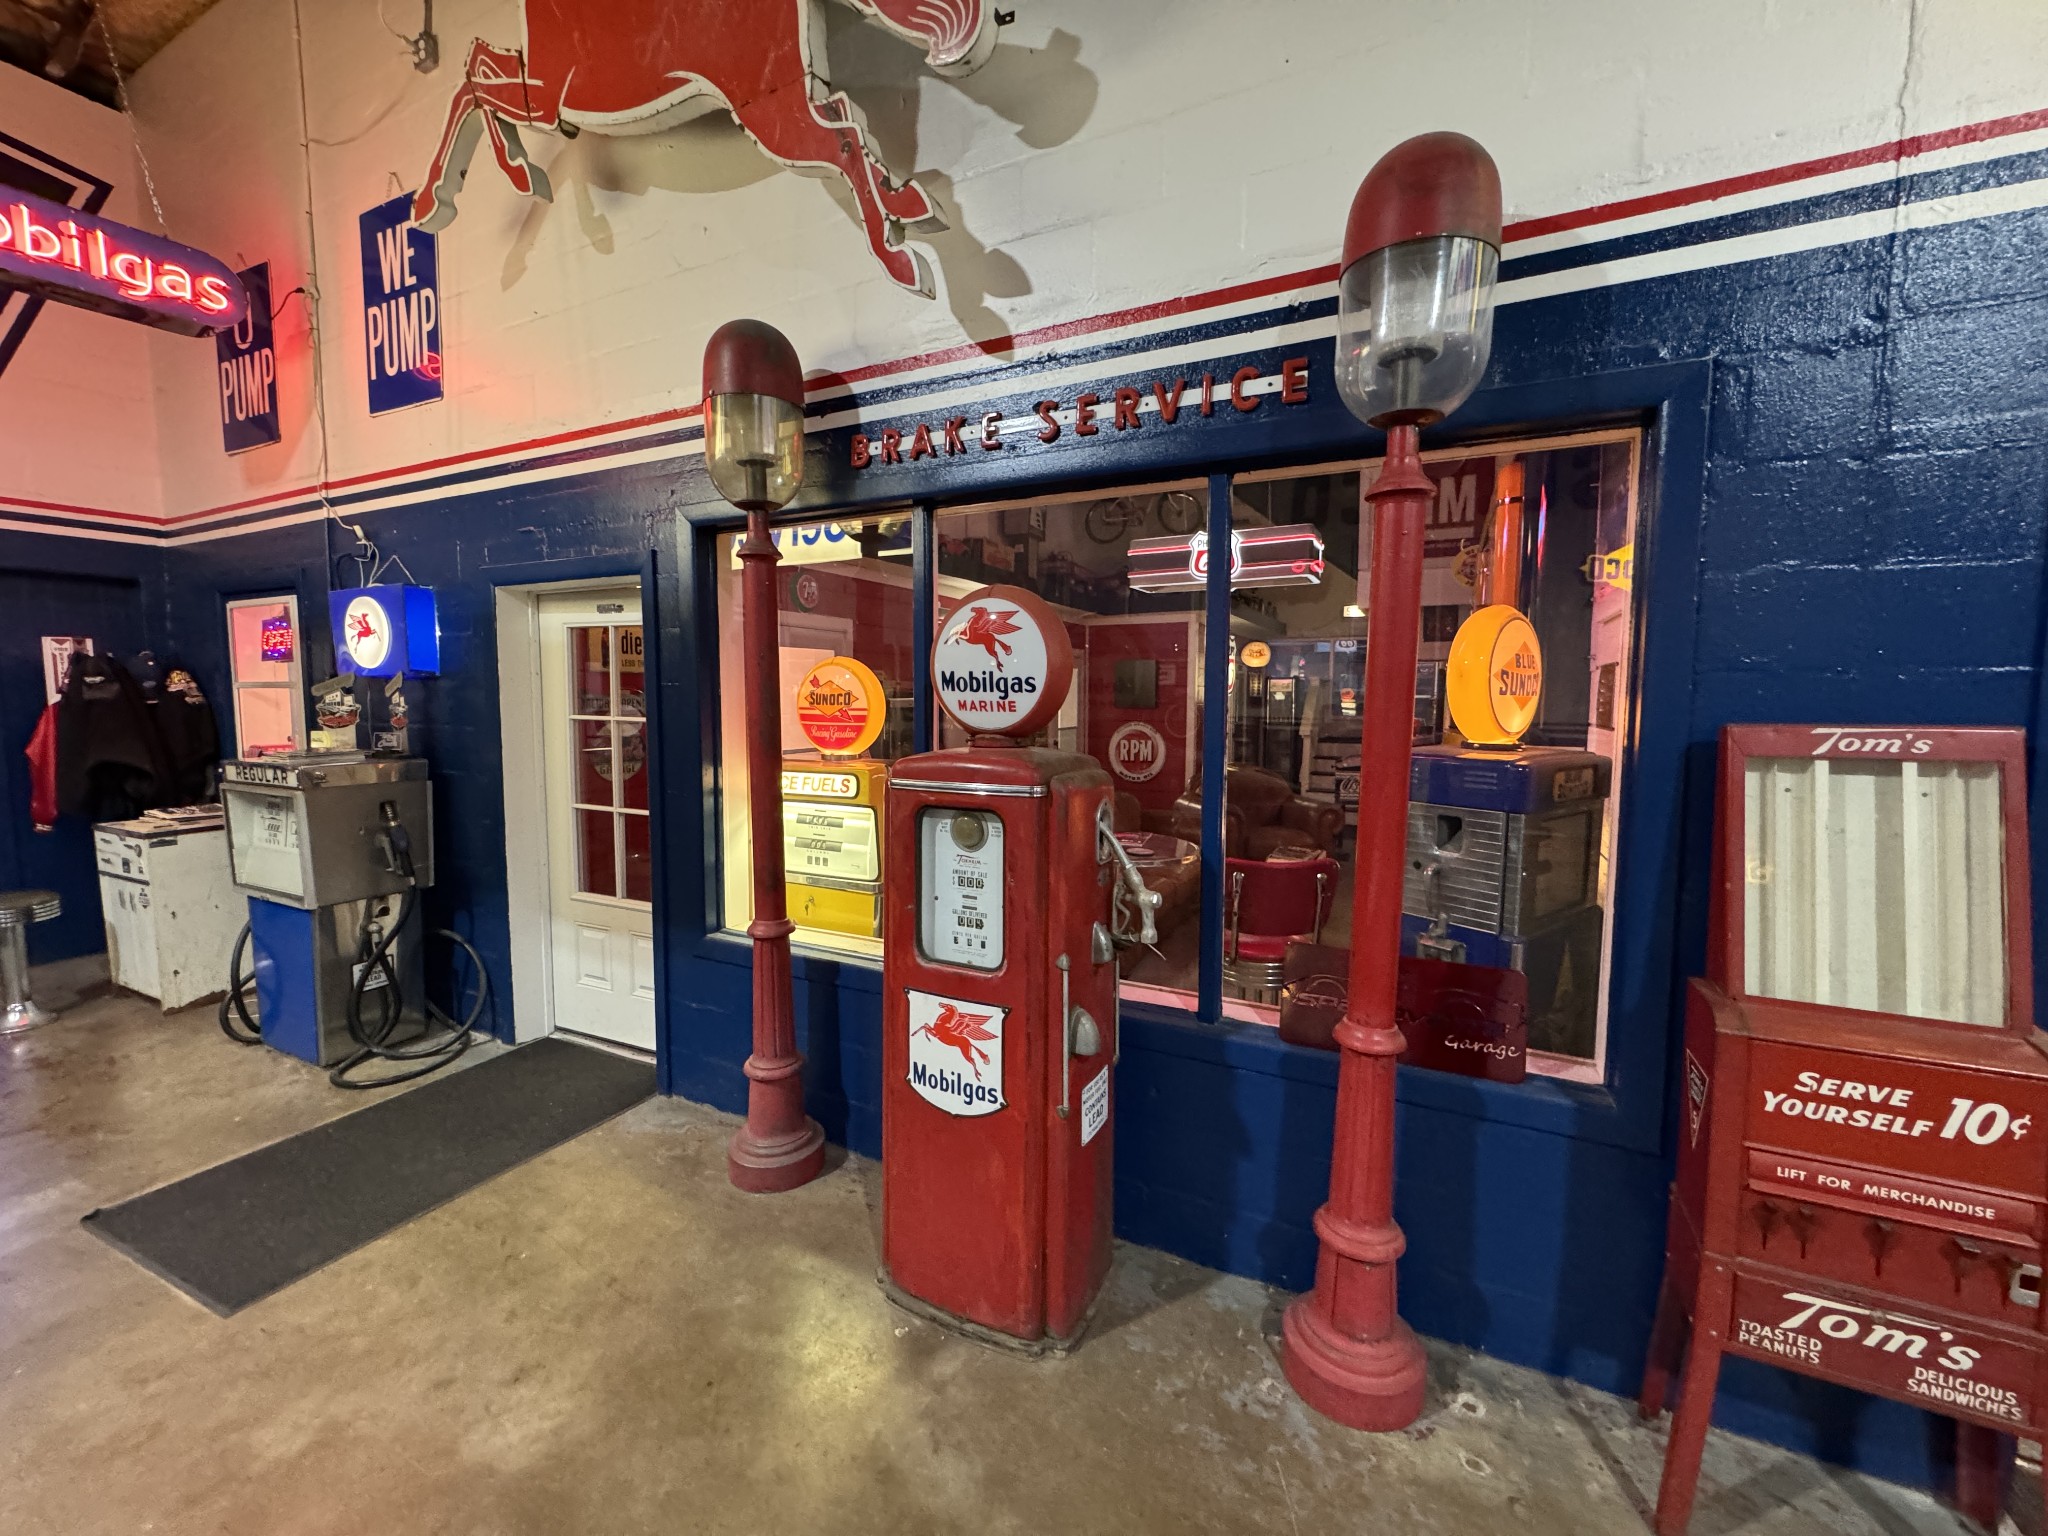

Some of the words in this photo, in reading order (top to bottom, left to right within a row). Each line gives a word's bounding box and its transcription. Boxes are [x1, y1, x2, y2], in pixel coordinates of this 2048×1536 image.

[377, 223, 416, 295] WE
[367, 287, 437, 382] PUMP
[220, 347, 276, 425] PUMP
[851, 411, 1003, 470] BRAKE
[1037, 355, 1310, 443] SERVICE
[1514, 653, 1536, 670] BLUE
[809, 690, 852, 706] SUNOCO
[941, 670, 1037, 700] Mobilgas
[957, 699, 1017, 713] MARINE
[810, 726, 831, 741] Racing
[830, 726, 857, 742] Gasoline
[1119, 739, 1152, 762] RPM
[235, 765, 289, 785] REGULAR
[802, 776, 851, 794] FUELS
[1444, 1034, 1521, 1060] Garage
[912, 1061, 999, 1106] Mobilgas
[1793, 1071, 1914, 1108] SERVE
[1084, 1088, 1107, 1117] CONTAINS
[1088, 1103, 1104, 1128] LEAD
[1762, 1090, 1935, 1138] YOURSELF
[1776, 1166, 1808, 1182] LIFT
[1817, 1174, 1851, 1191] FOR
[1863, 1183, 1997, 1220] MERCHANDISE
[1738, 1331, 1821, 1365] PEANUTS
[1739, 1318, 1823, 1352] TOASTED
[1779, 1292, 1982, 1372] Tom's
[1906, 1378, 2023, 1422] SANDWICHES
[1914, 1366, 2018, 1406] DELICIOUS
